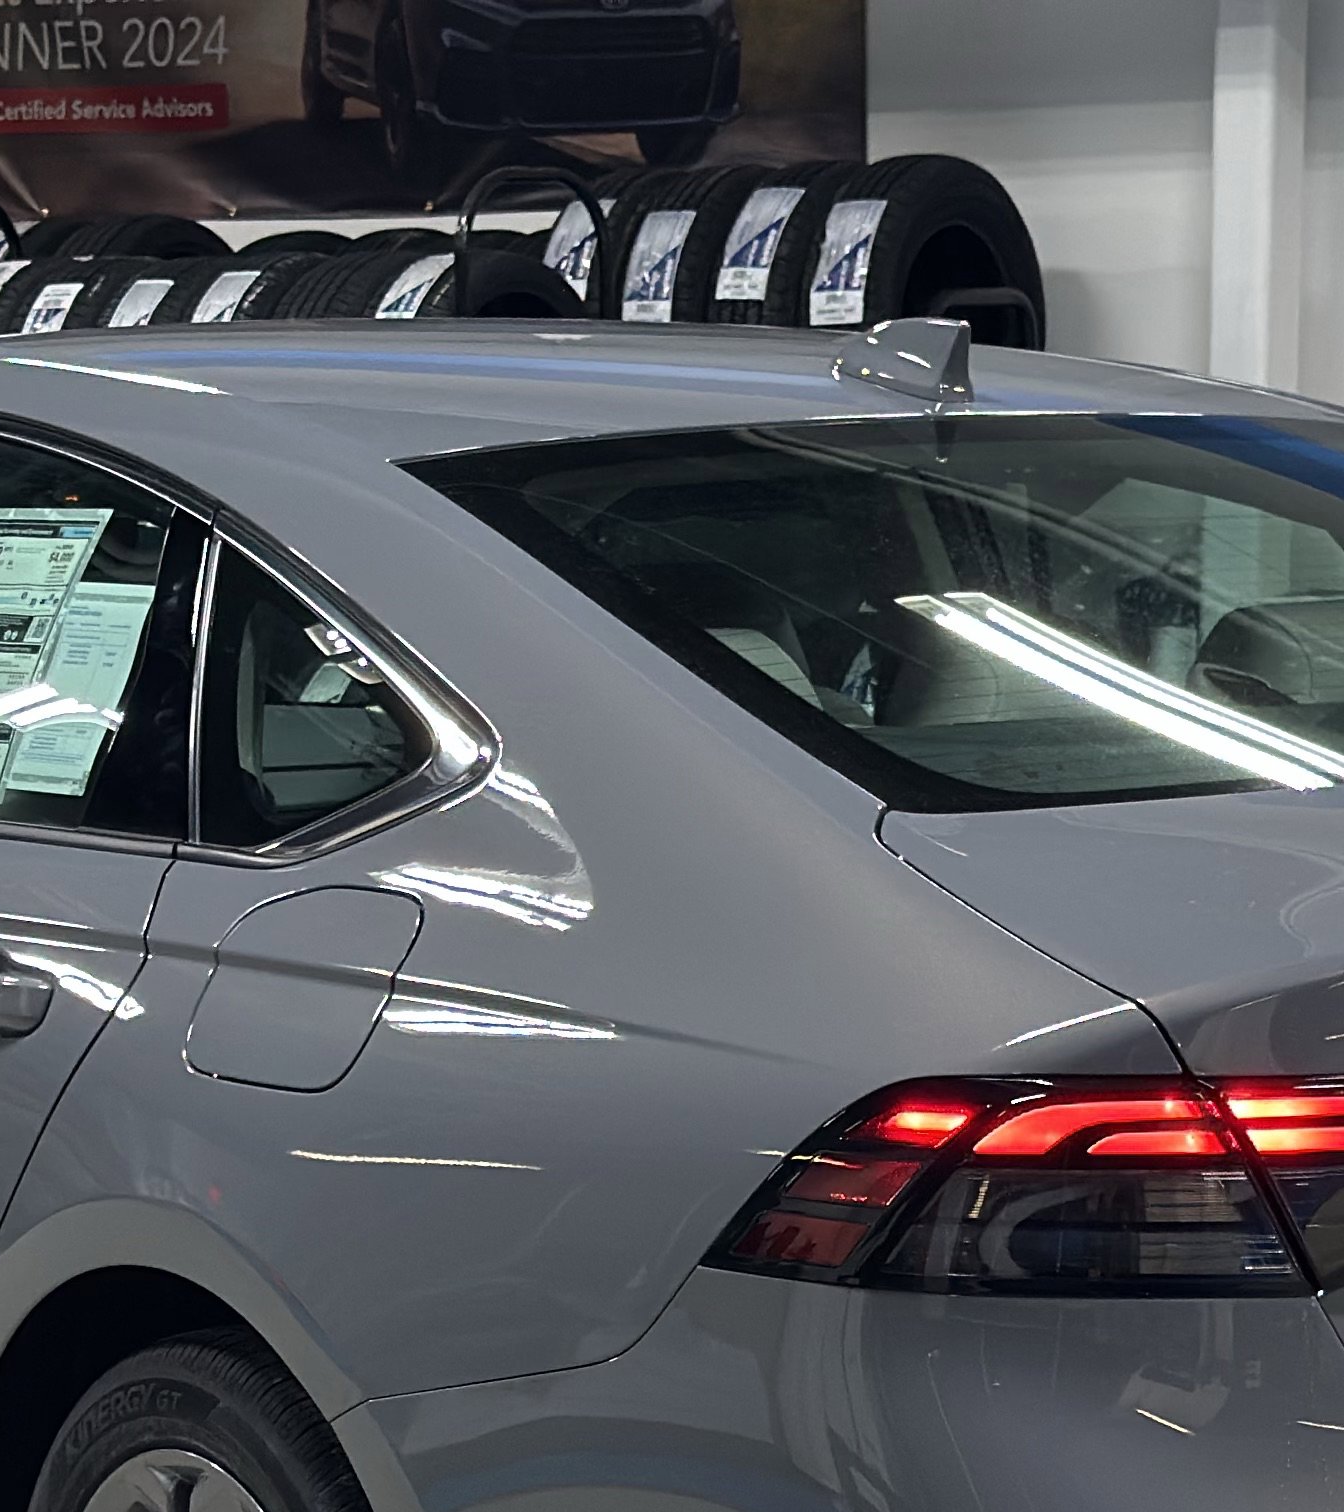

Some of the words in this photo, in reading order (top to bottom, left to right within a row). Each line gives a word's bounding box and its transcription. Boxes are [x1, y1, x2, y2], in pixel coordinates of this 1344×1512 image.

[122, 15, 229, 68] 2024
[71, 99, 135, 120] Service
[141, 96, 214, 118] Advisors
[156, 1389, 184, 1410] GT
